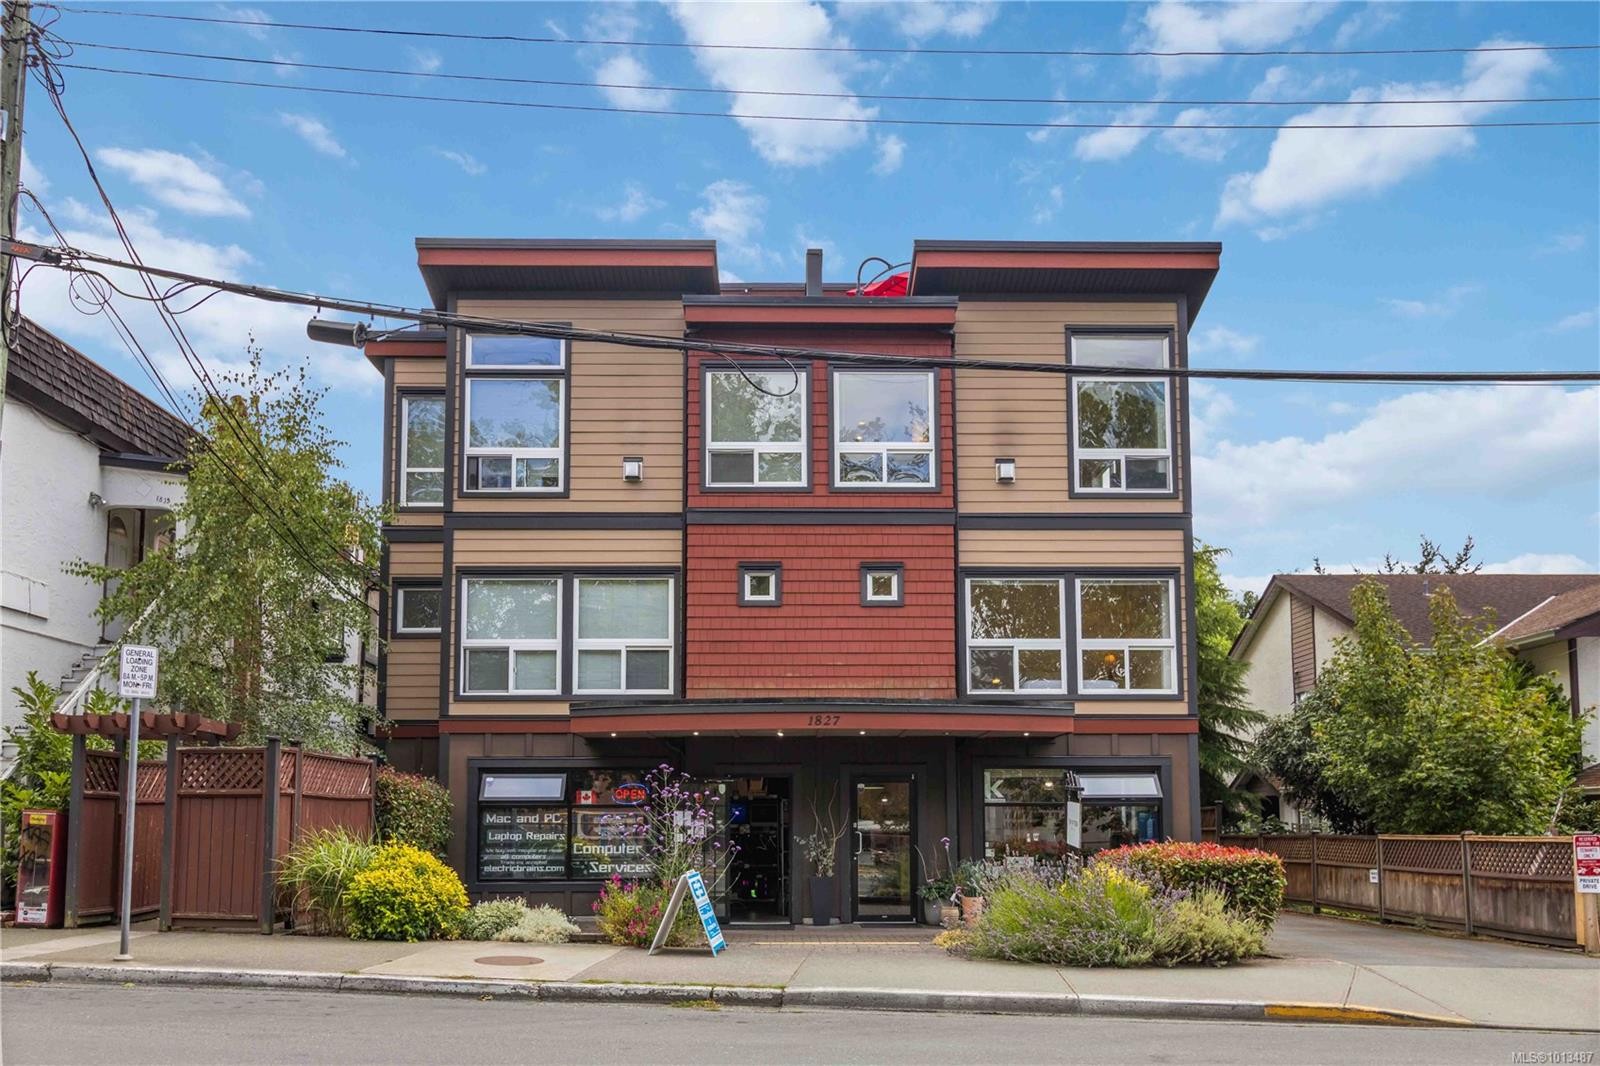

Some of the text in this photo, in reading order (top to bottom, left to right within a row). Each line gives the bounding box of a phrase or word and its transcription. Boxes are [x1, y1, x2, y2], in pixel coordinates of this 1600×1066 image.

[125, 649, 154, 658] GENERAL
[126, 657, 153, 666] LOADING
[130, 665, 147, 673] ZONE
[807, 714, 841, 726] 1827
[615, 789, 647, 800] OPEN
[486, 812, 564, 824] Mac and PC
[488, 831, 566, 842] Laptop Repairs
[573, 843, 643, 857] Computer
[511, 854, 547, 862] computers
[589, 861, 653, 874] Services
